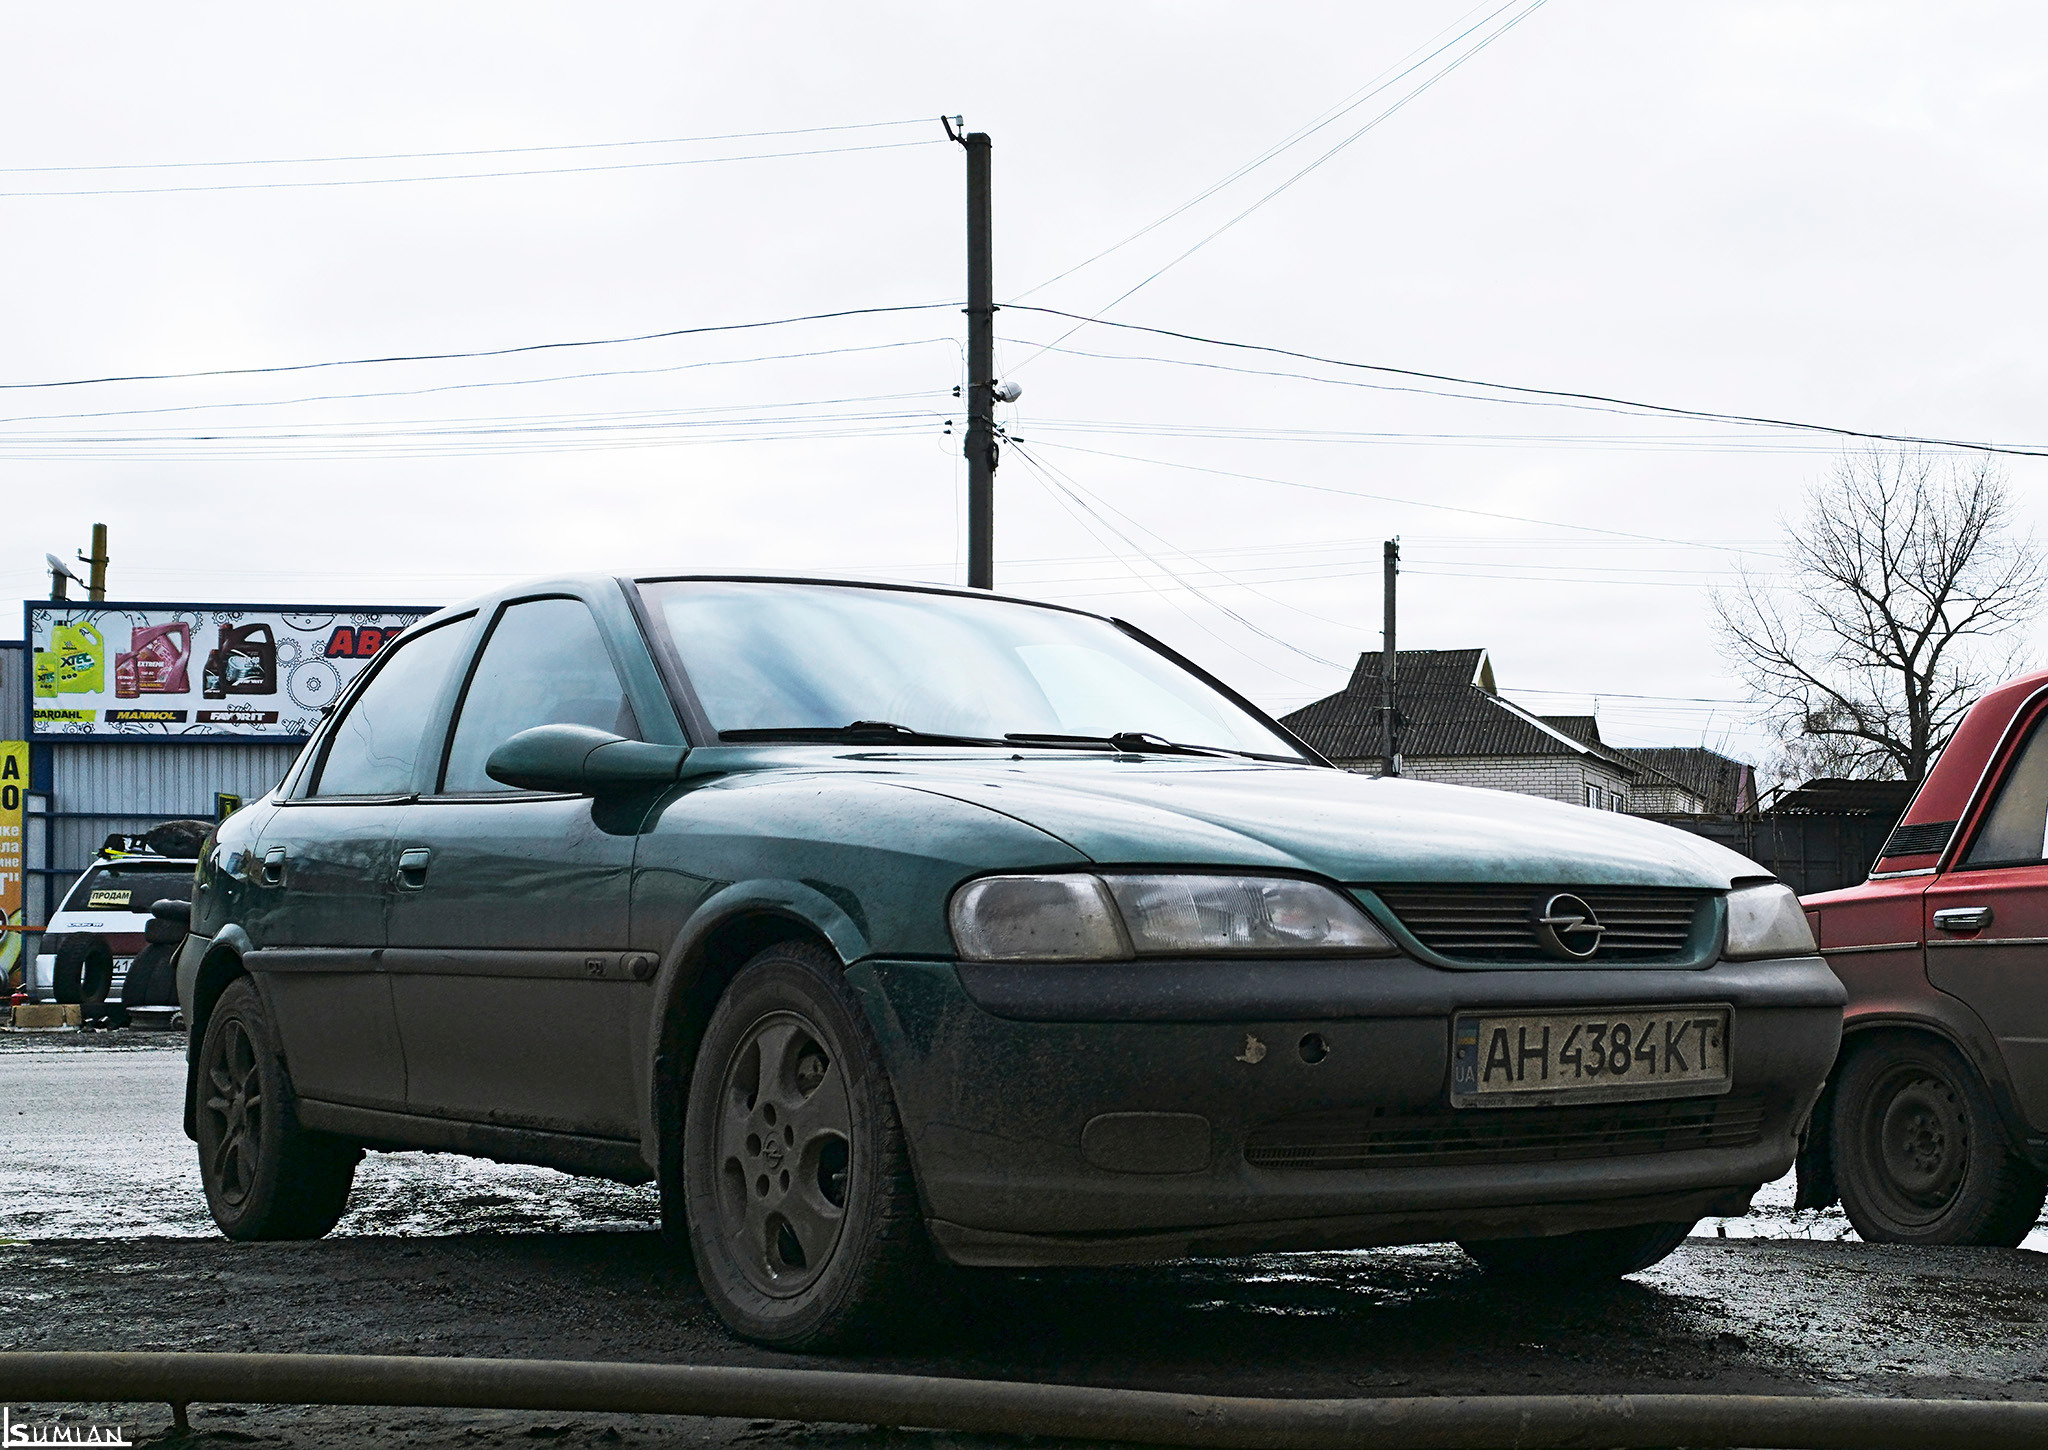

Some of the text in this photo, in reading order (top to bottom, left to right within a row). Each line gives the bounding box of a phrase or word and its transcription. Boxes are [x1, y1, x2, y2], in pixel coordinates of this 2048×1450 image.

[33, 710, 83, 720] BARDAHL
[116, 711, 176, 720] MANNOL
[209, 712, 266, 721] FAVORIT
[91, 891, 130, 901] ПРОДАМ
[1455, 1066, 1476, 1083] UA
